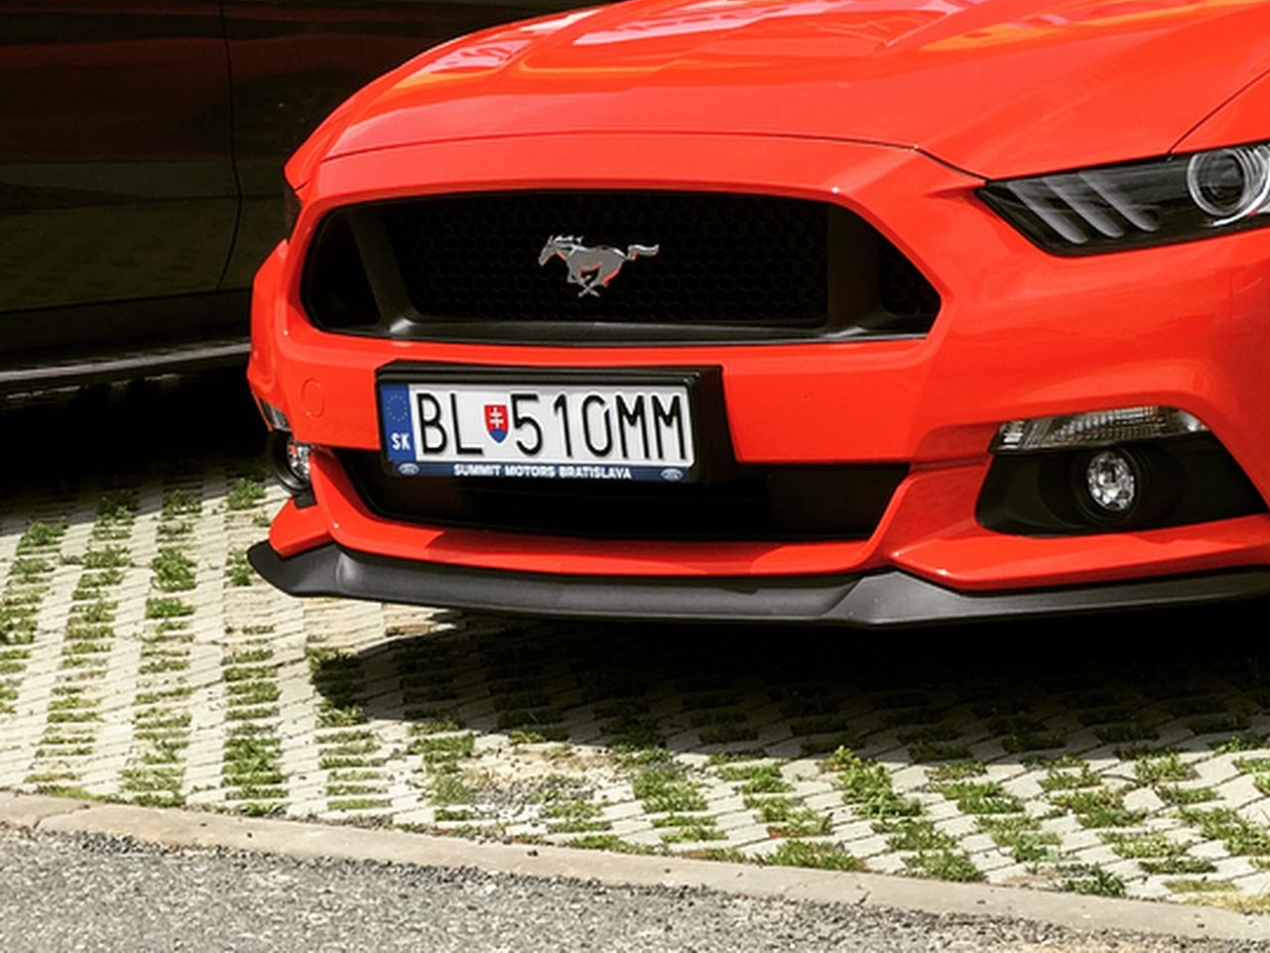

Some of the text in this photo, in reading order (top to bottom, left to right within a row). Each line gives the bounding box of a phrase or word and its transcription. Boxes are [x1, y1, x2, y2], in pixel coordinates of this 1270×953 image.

[391, 433, 411, 451] SK
[454, 464, 632, 479] SUMMIT MOTORS BRATISLAVA
